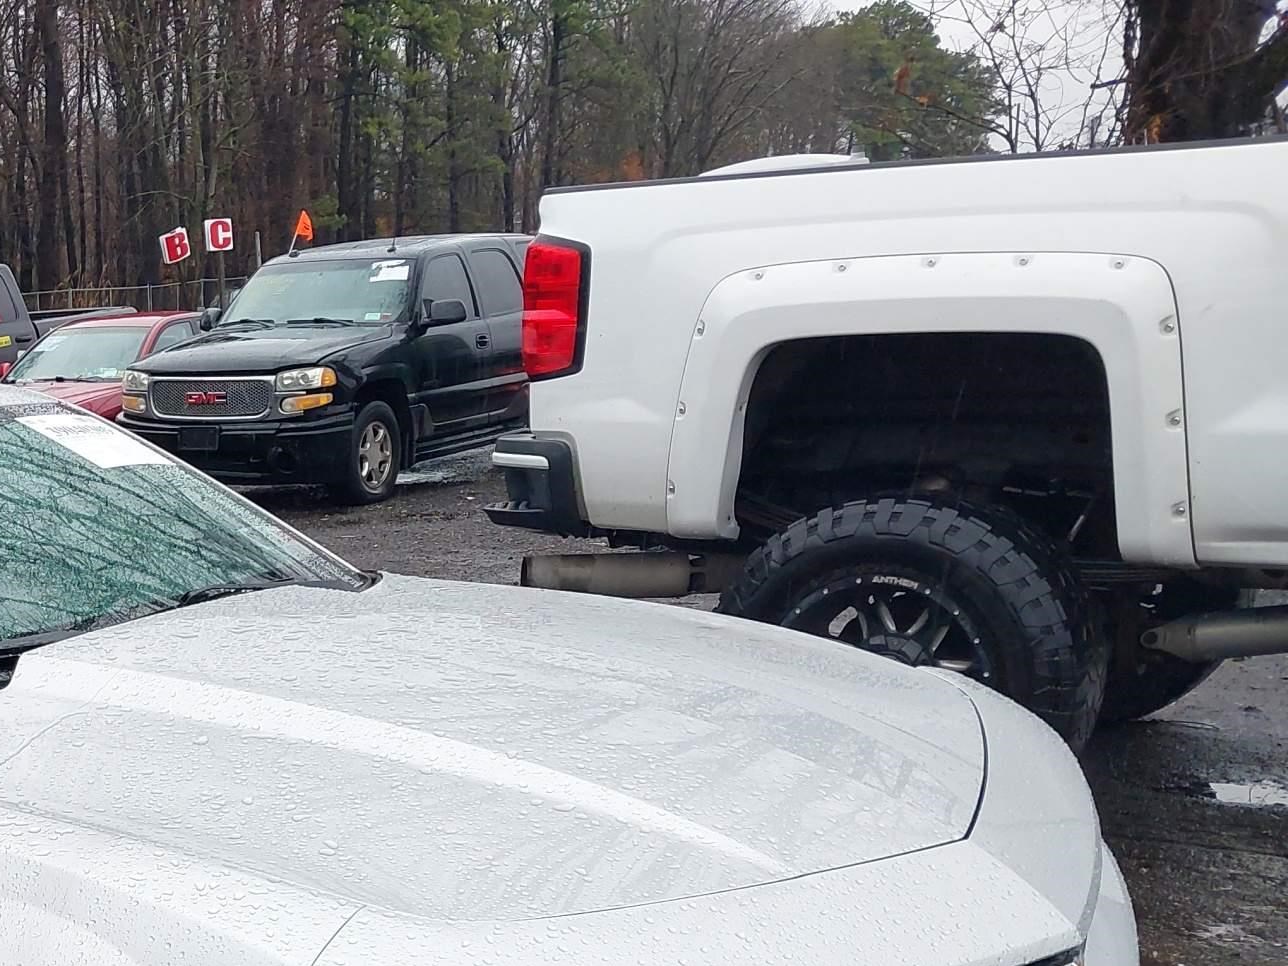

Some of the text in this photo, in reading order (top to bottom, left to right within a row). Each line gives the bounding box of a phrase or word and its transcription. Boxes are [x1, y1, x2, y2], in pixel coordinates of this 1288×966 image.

[166, 233, 189, 261] B
[210, 220, 231, 249] C
[185, 391, 227, 405] GMC
